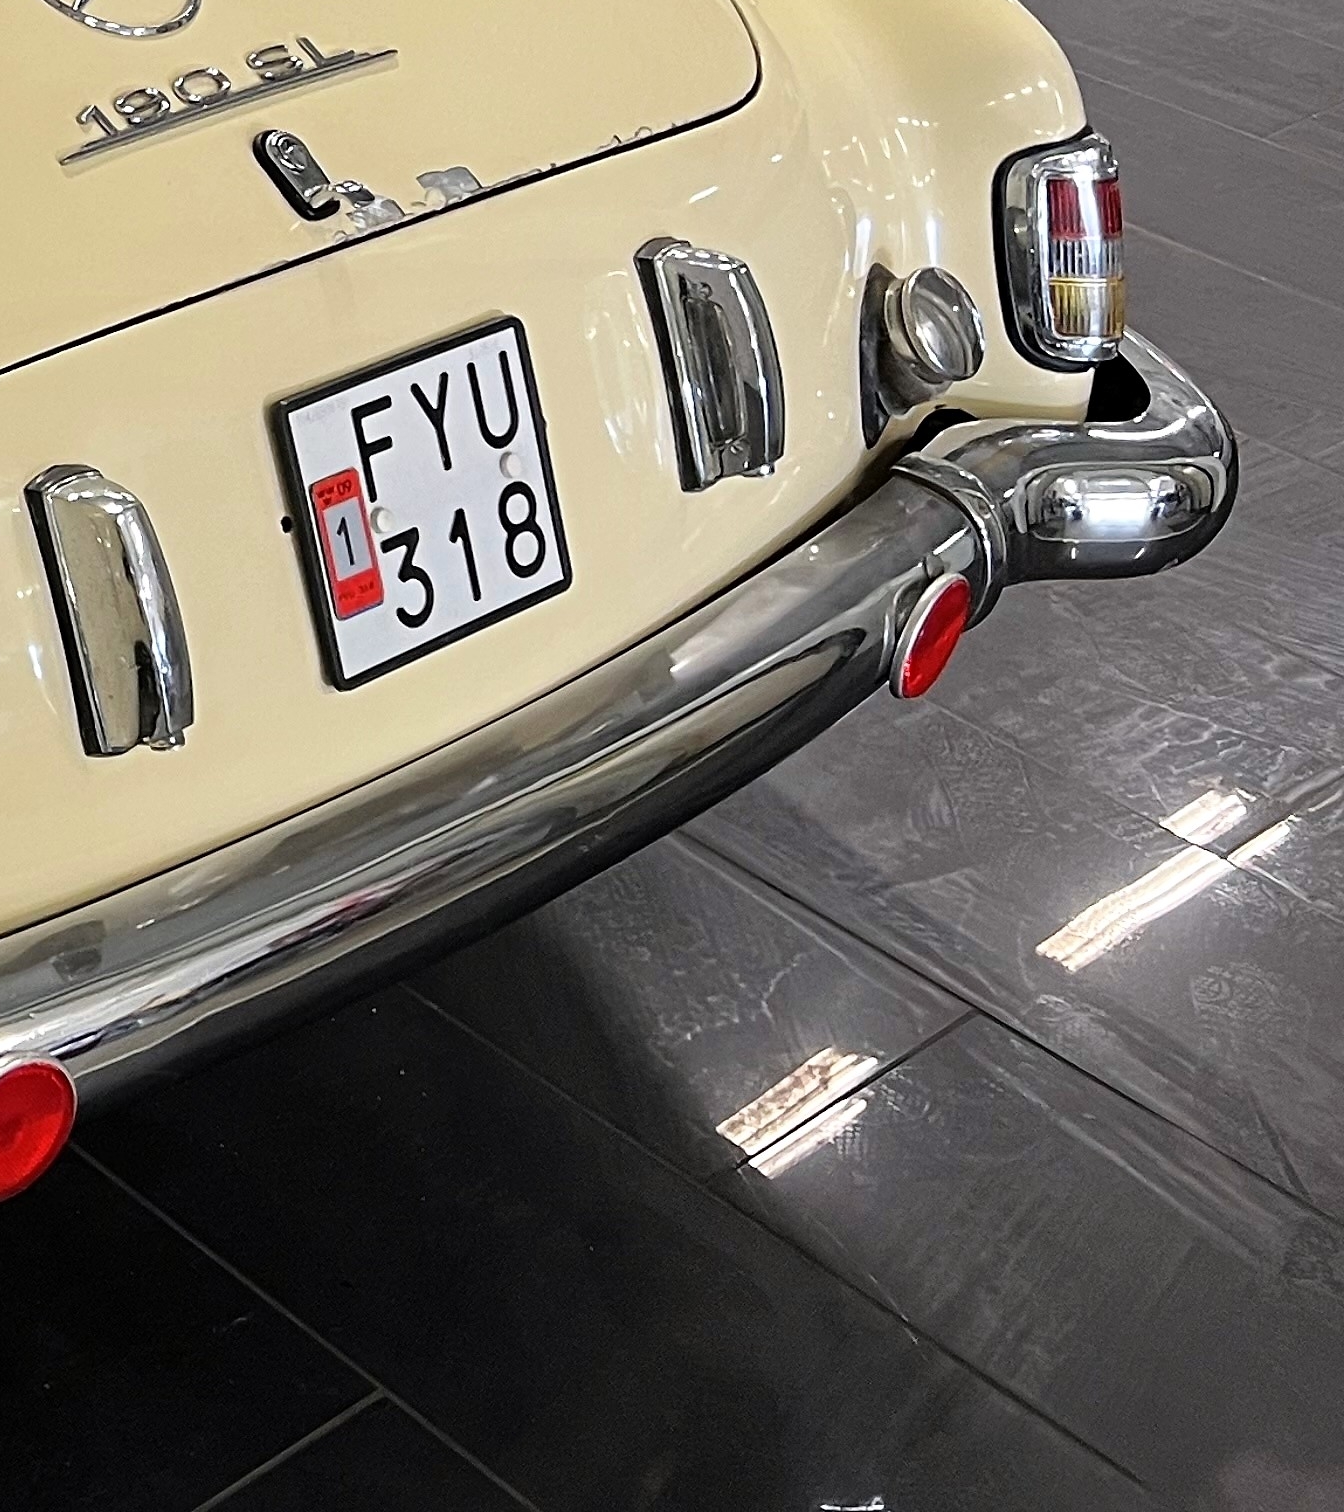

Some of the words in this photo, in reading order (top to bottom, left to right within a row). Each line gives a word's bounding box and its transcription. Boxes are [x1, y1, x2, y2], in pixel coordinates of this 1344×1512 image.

[76, 67, 231, 136] 190
[246, 36, 356, 80] SL
[350, 350, 519, 503] FYU
[336, 516, 355, 566] 1
[380, 481, 546, 628] 318
